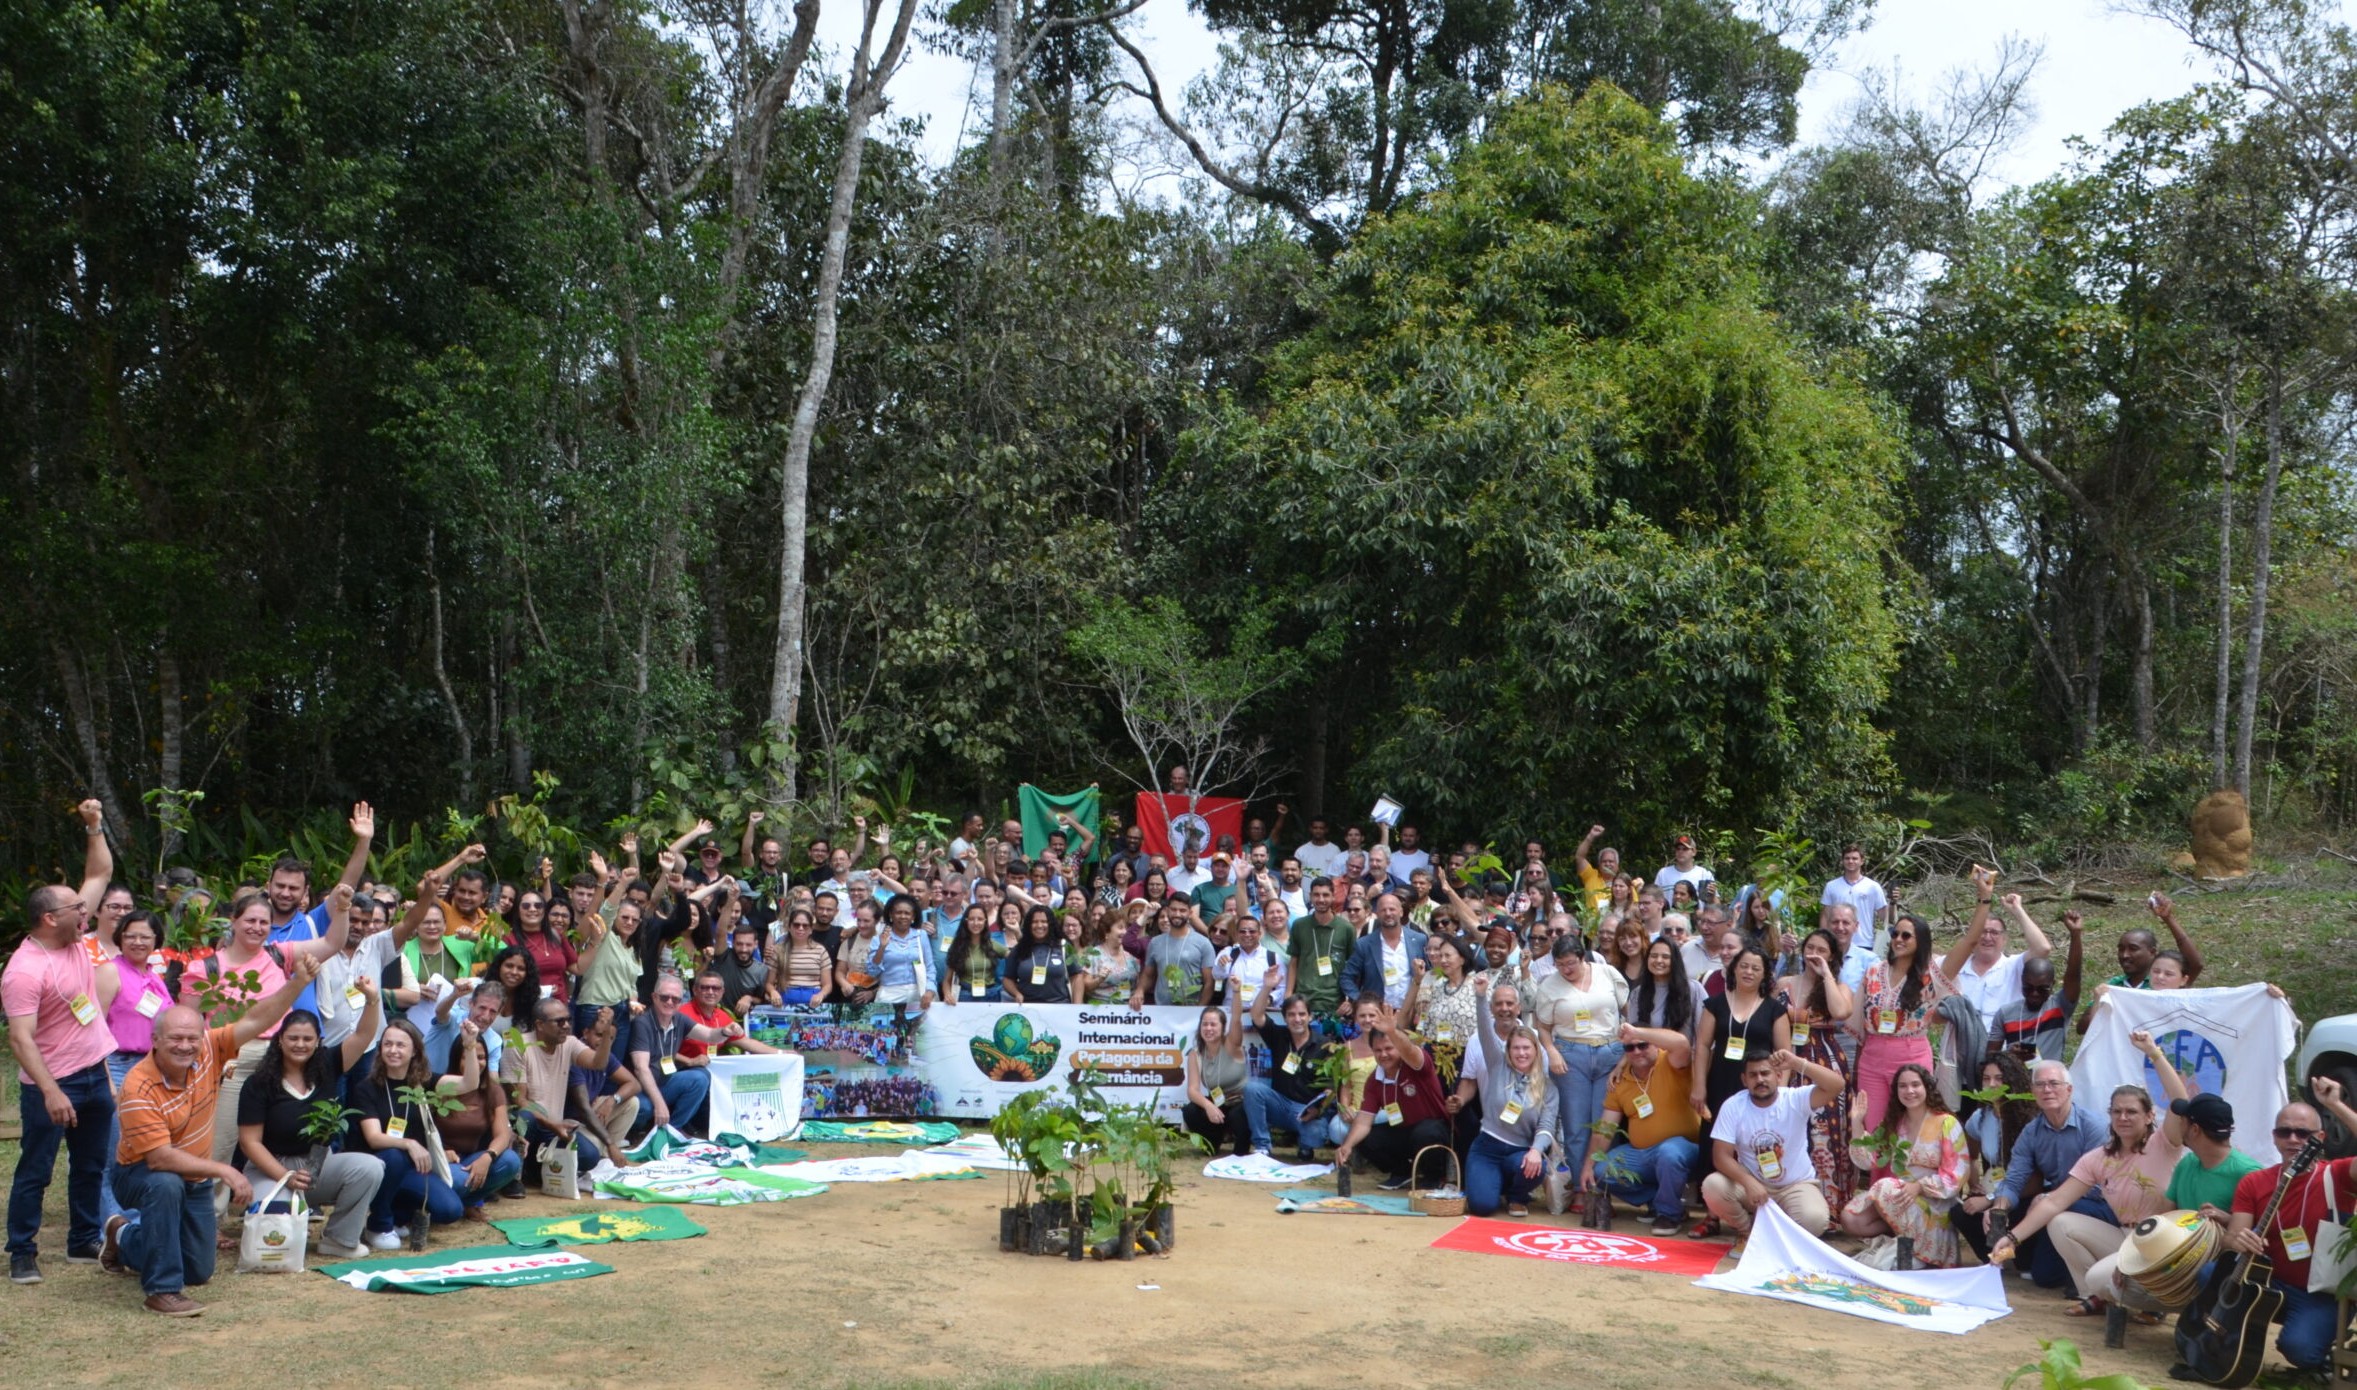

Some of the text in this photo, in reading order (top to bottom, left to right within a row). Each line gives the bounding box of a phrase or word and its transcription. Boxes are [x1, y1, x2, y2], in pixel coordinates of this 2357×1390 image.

[1079, 1012, 1152, 1025] Seminário
[1079, 1031, 1175, 1045] Internacional
[1077, 1050, 1174, 1067] Pedagogia da
